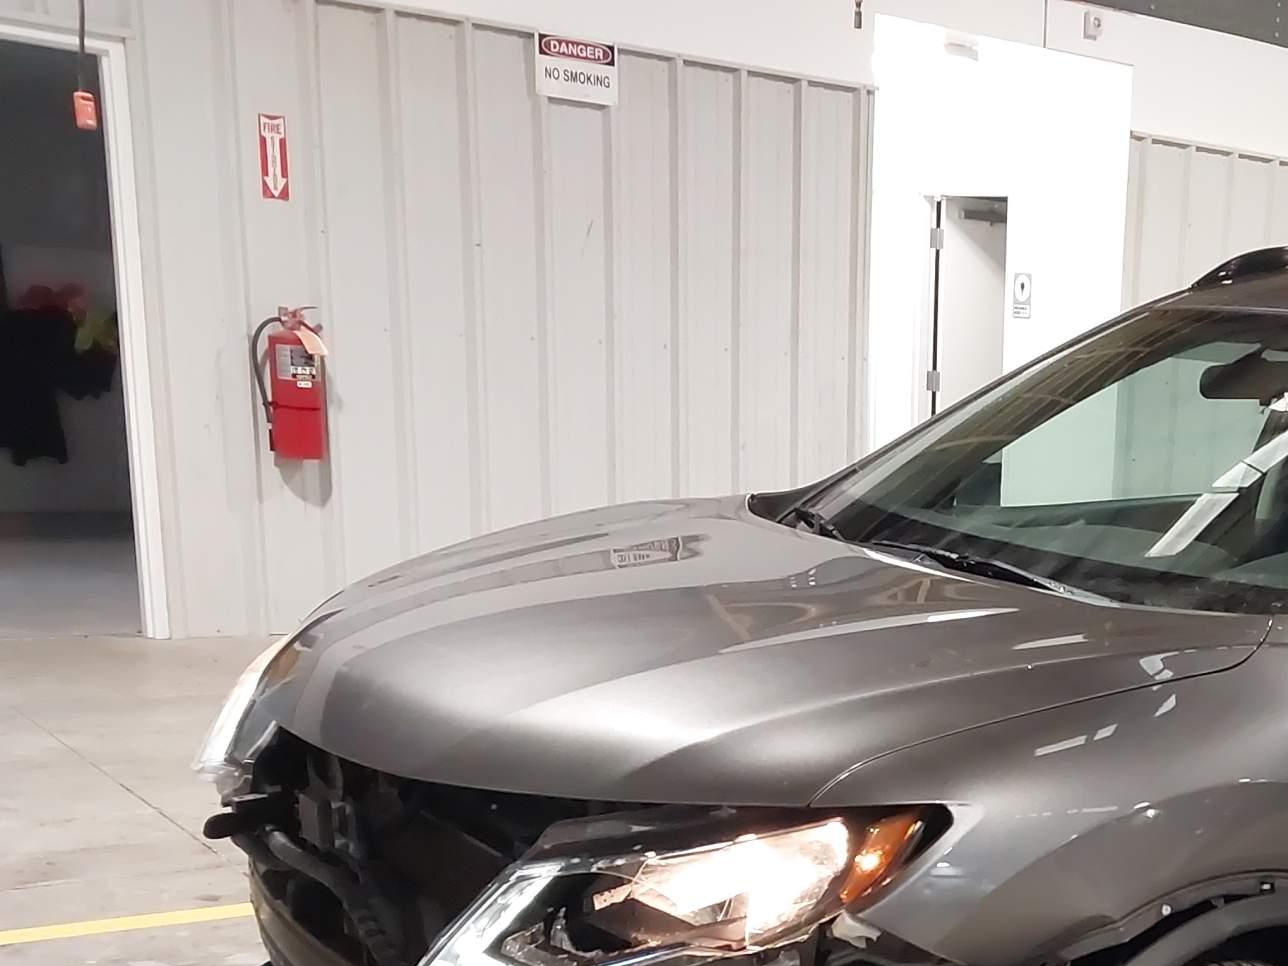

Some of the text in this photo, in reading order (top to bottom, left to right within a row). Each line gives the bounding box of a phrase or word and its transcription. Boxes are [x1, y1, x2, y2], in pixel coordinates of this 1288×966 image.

[550, 40, 604, 60] DANGER
[544, 67, 611, 88] NO SMOKING
[263, 122, 282, 135] FIRE
